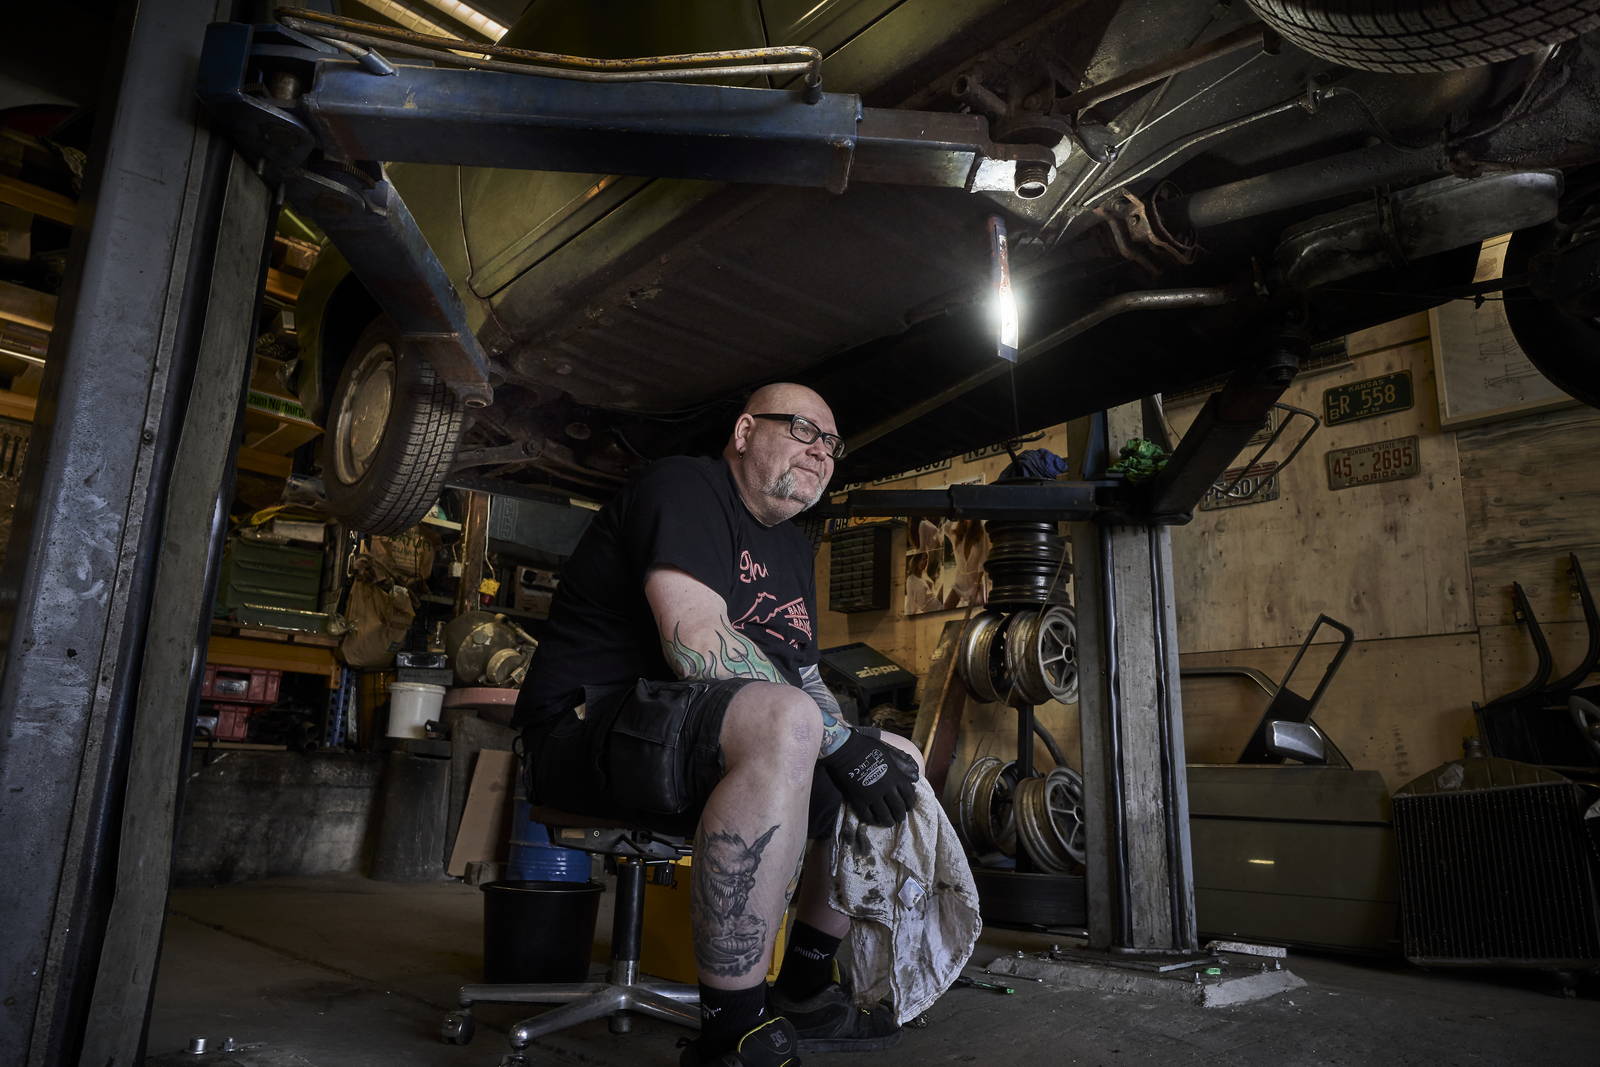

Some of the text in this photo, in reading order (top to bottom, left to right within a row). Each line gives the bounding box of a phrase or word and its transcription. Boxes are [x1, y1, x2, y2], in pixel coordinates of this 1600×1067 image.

[1361, 384, 1396, 409] 558
[1372, 446, 1413, 472] 2695
[1349, 470, 1397, 483] FLORIDA
[856, 664, 900, 679] zippo
